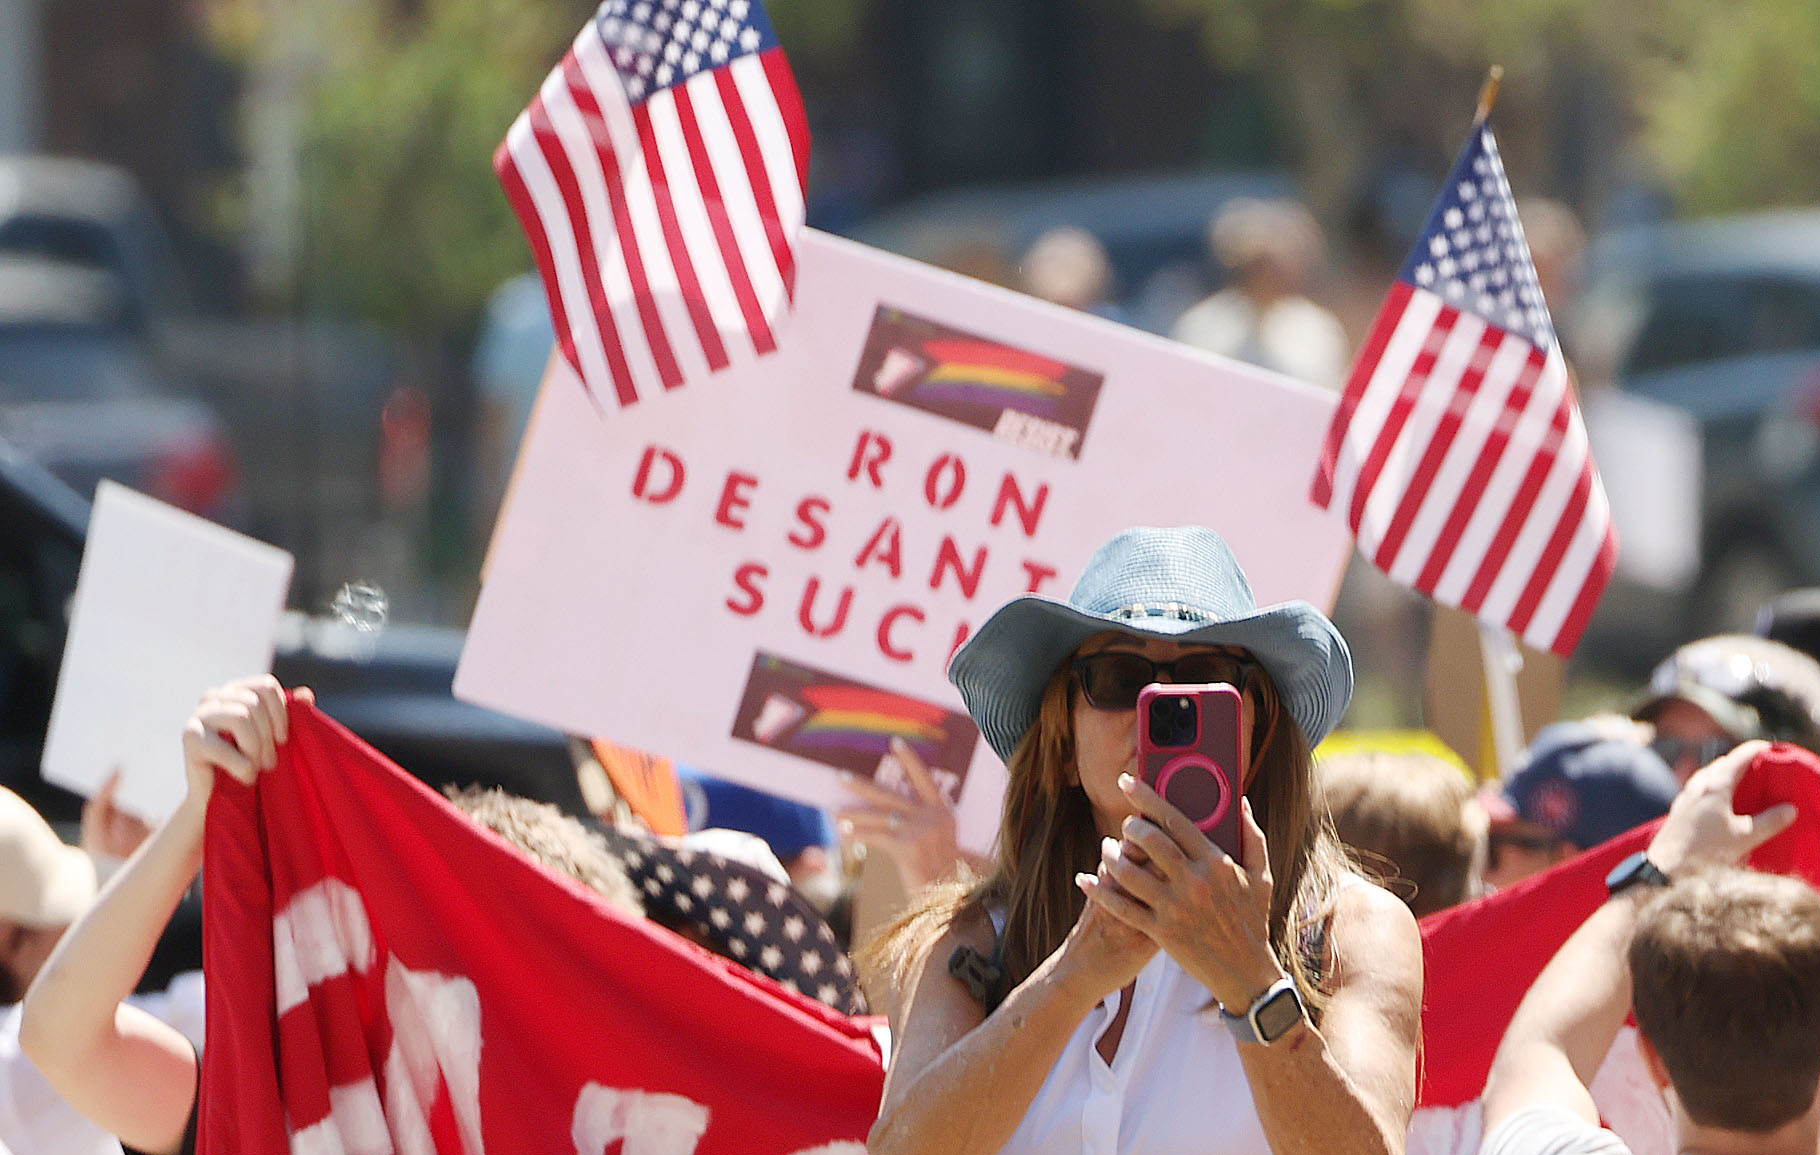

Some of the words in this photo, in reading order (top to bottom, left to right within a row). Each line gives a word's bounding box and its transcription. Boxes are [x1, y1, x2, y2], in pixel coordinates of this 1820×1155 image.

[632, 445, 1058, 600] DESANT
[847, 430, 1049, 538] RON
[726, 562, 968, 664] SUC
